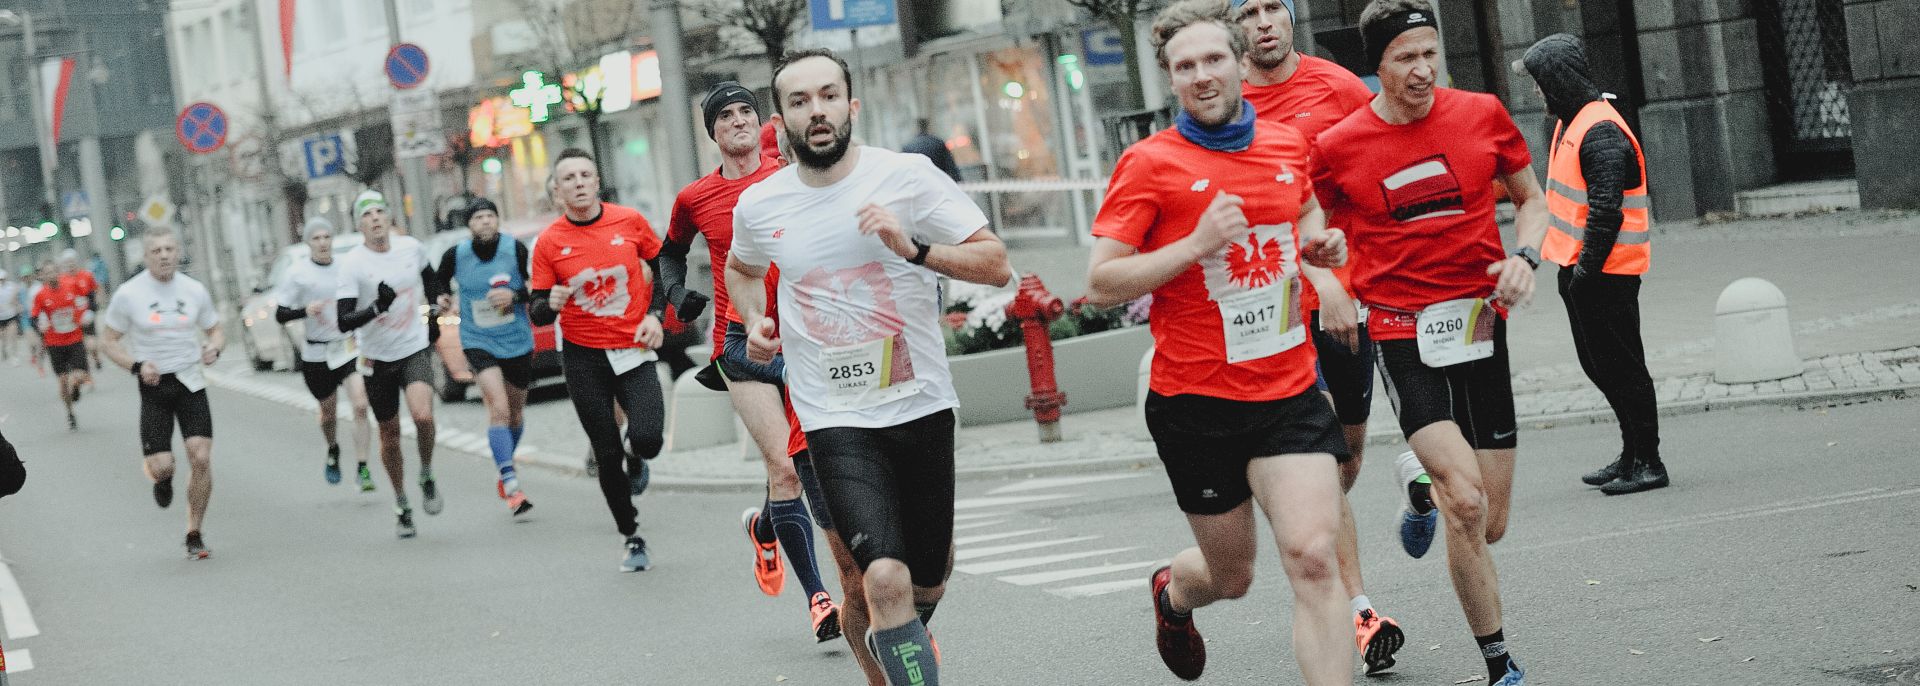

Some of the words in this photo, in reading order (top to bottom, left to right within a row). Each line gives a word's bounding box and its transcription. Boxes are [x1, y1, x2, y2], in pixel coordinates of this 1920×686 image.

[1233, 304, 1275, 326] 4017
[1425, 318, 1463, 335] 4260
[829, 361, 875, 379] 2853
[892, 641, 925, 686] enji
